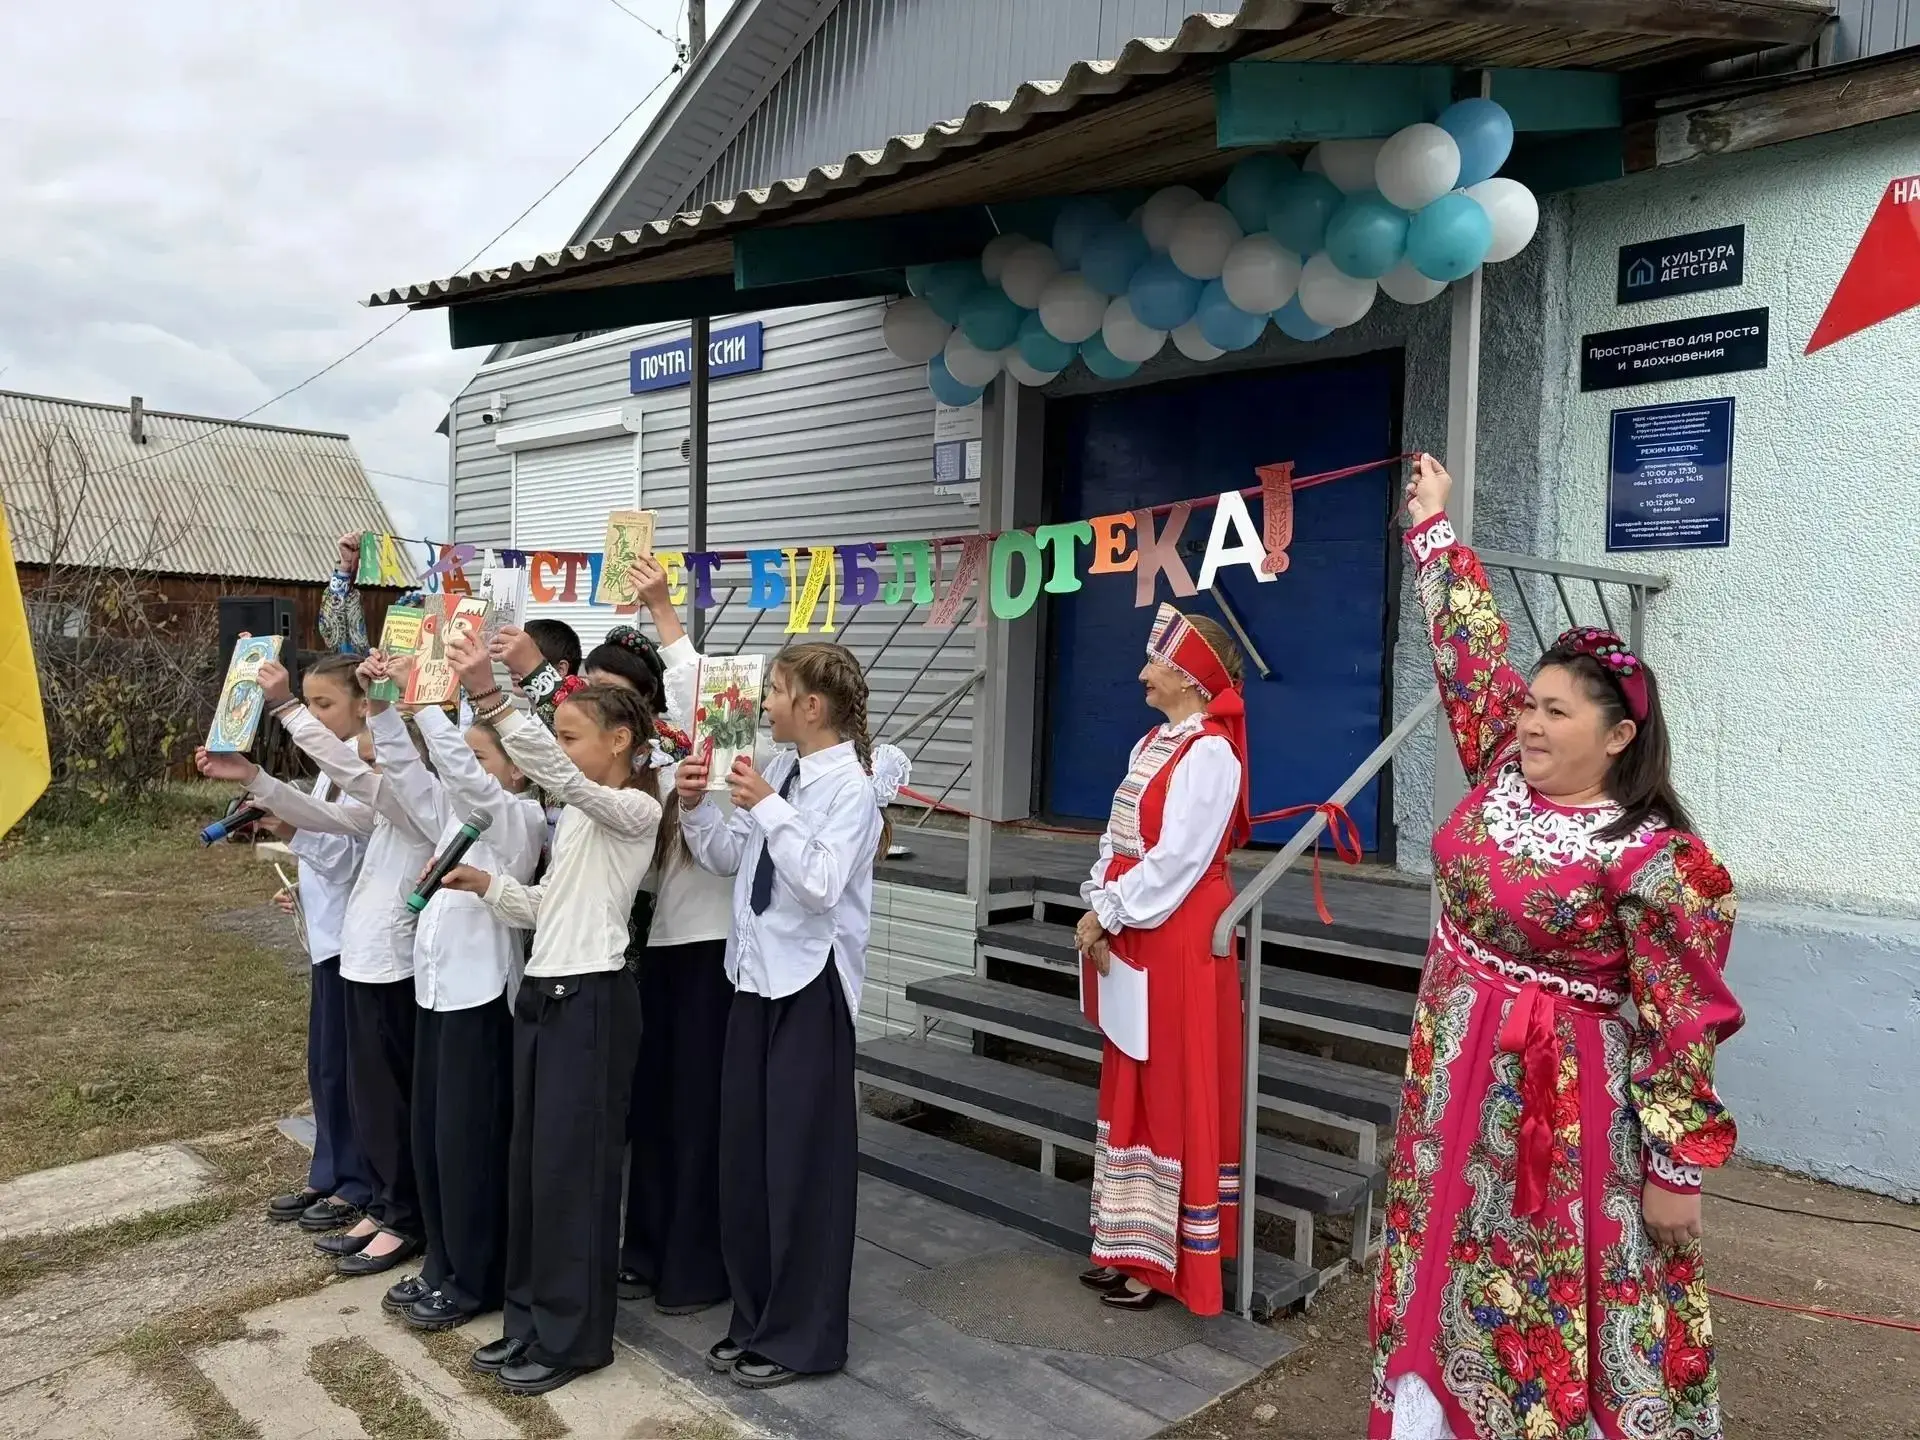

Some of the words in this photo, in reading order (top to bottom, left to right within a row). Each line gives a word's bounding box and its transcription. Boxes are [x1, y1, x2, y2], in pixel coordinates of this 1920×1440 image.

[1661, 244, 1735, 268] КУЛЬТУРА
[1661, 260, 1728, 282] ДЕТСТВА
[1590, 337, 1684, 360] Пространство
[1688, 332, 1713, 346] для
[1716, 326, 1759, 343] роста
[640, 350, 685, 380] ПОЧТА
[689, 336, 745, 371] ССИИ
[1618, 362, 1626, 370] и
[1633, 348, 1724, 369] вдохновения
[1641, 447, 1666, 455] РЕЖИМ
[1667, 445, 1698, 453] РАБОТЫ:
[747, 461, 1294, 633] БИБЛИОТЕКА!
